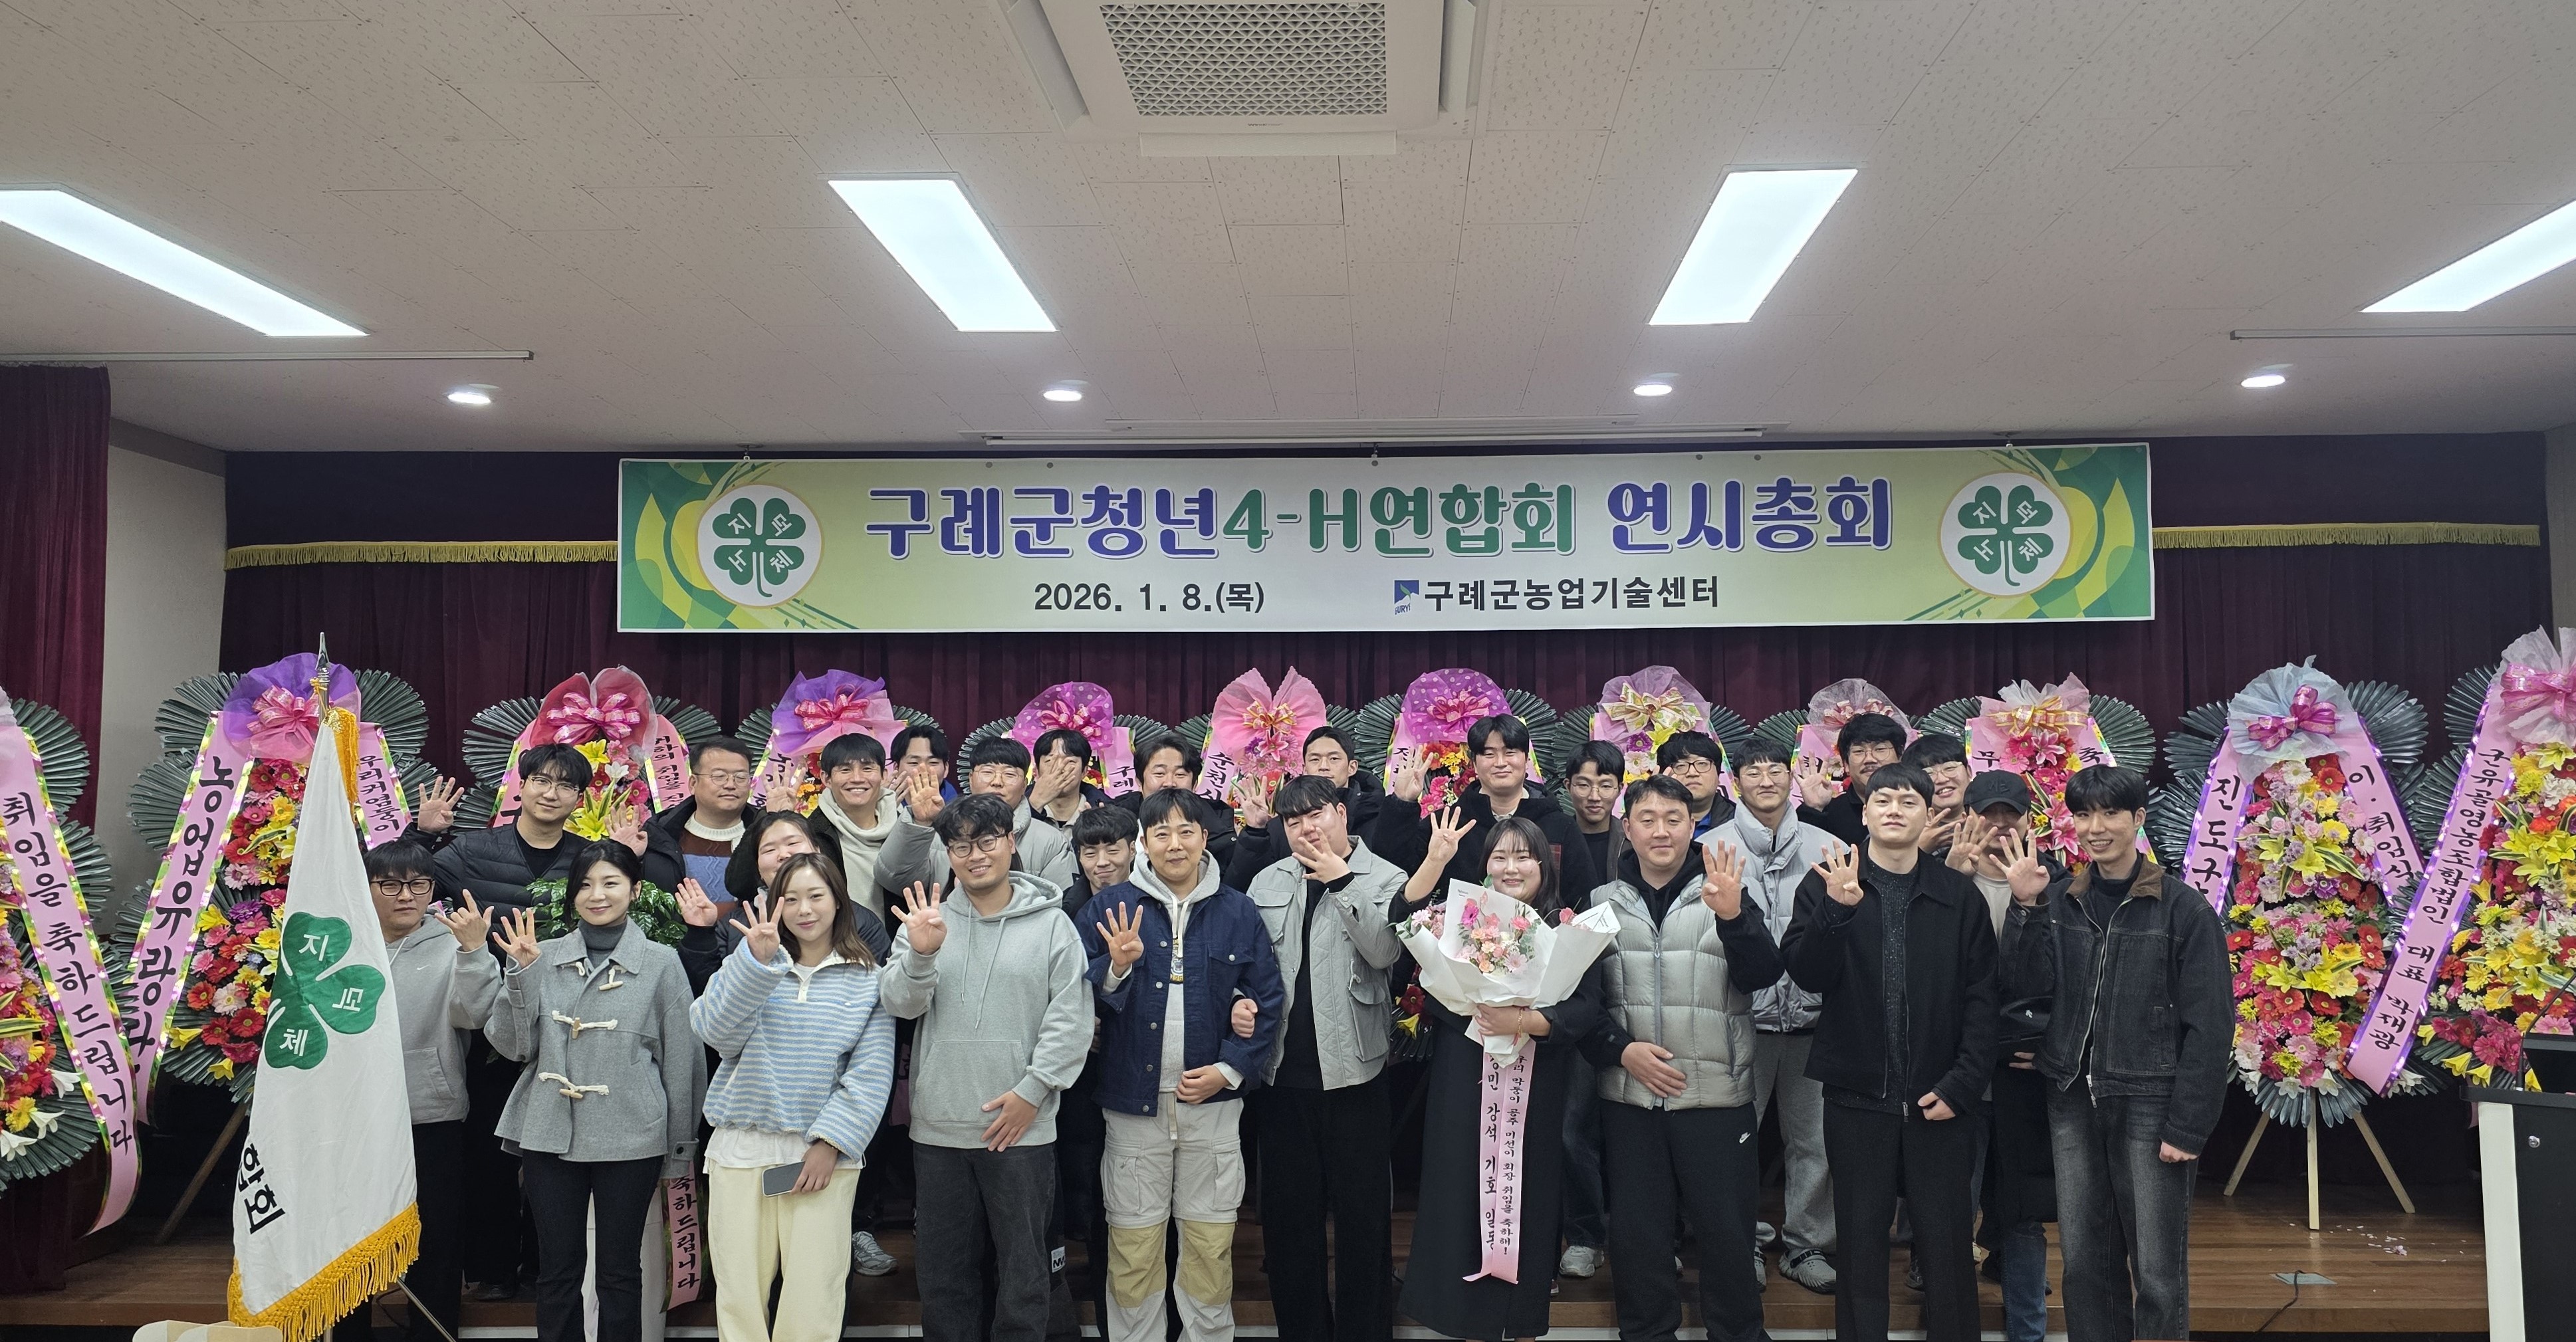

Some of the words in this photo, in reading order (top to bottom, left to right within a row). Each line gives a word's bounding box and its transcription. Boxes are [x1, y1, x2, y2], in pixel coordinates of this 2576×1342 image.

[866, 481, 1577, 560] 구례군청년4-H연합회
[1607, 473, 1893, 556] 연시총회
[1034, 582, 1121, 613] 2026.
[1139, 582, 1166, 612] 1.
[1181, 580, 1265, 614] 8.(목)
[1424, 576, 1720, 612] 구례군농업기술센터
[2191, 774, 2240, 895] 진도군
[298, 933, 330, 963] 지
[2396, 945, 2436, 984] 대표
[2, 792, 68, 907] 취임을
[43, 922, 133, 1156] 축하드립니다
[2369, 994, 2414, 1050] 박재광
[279, 1027, 308, 1058] 체
[1485, 1103, 1500, 1143] 강석
[1484, 1155, 1497, 1194] 기호
[670, 1174, 700, 1289] 축하드립니다
